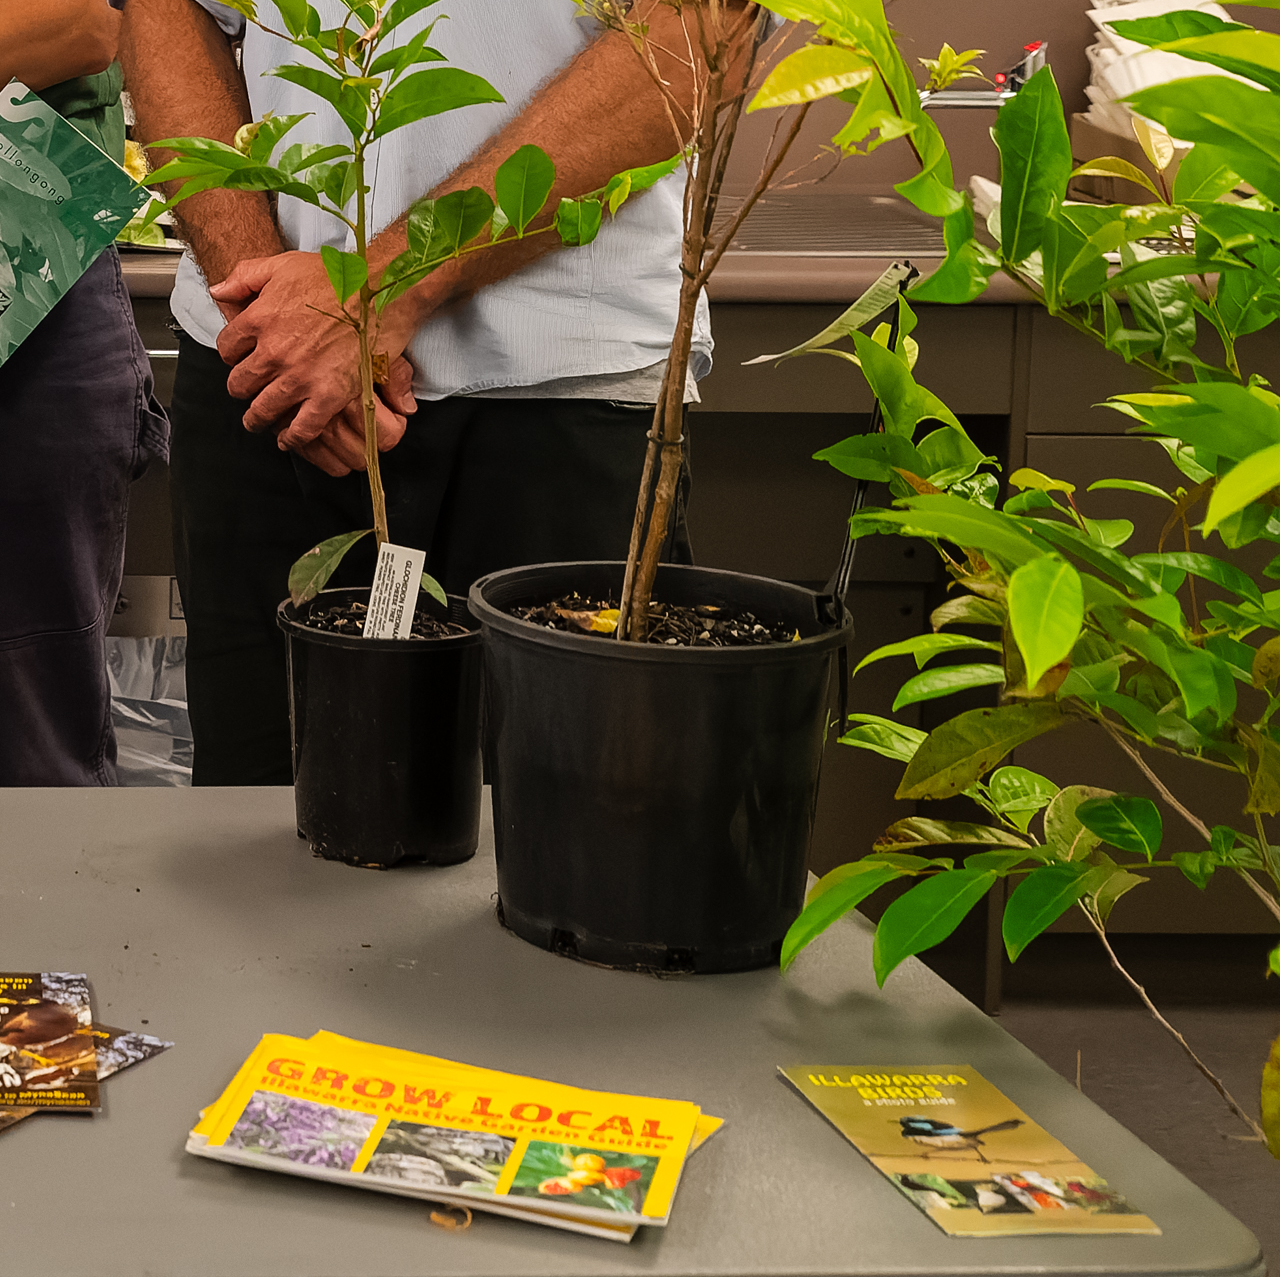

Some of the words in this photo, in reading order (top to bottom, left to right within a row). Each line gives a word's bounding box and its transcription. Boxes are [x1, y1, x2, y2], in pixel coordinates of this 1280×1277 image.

[265, 1056, 458, 1111] GROW
[471, 1095, 675, 1141] LOCAL
[807, 1072, 969, 1089] ILLAWARRA
[856, 1086, 943, 1101] BIRDS
[259, 1074, 379, 1112] Illawarra
[383, 1100, 476, 1131] Native
[479, 1115, 583, 1143] Garden
[585, 1129, 669, 1151] Guide
